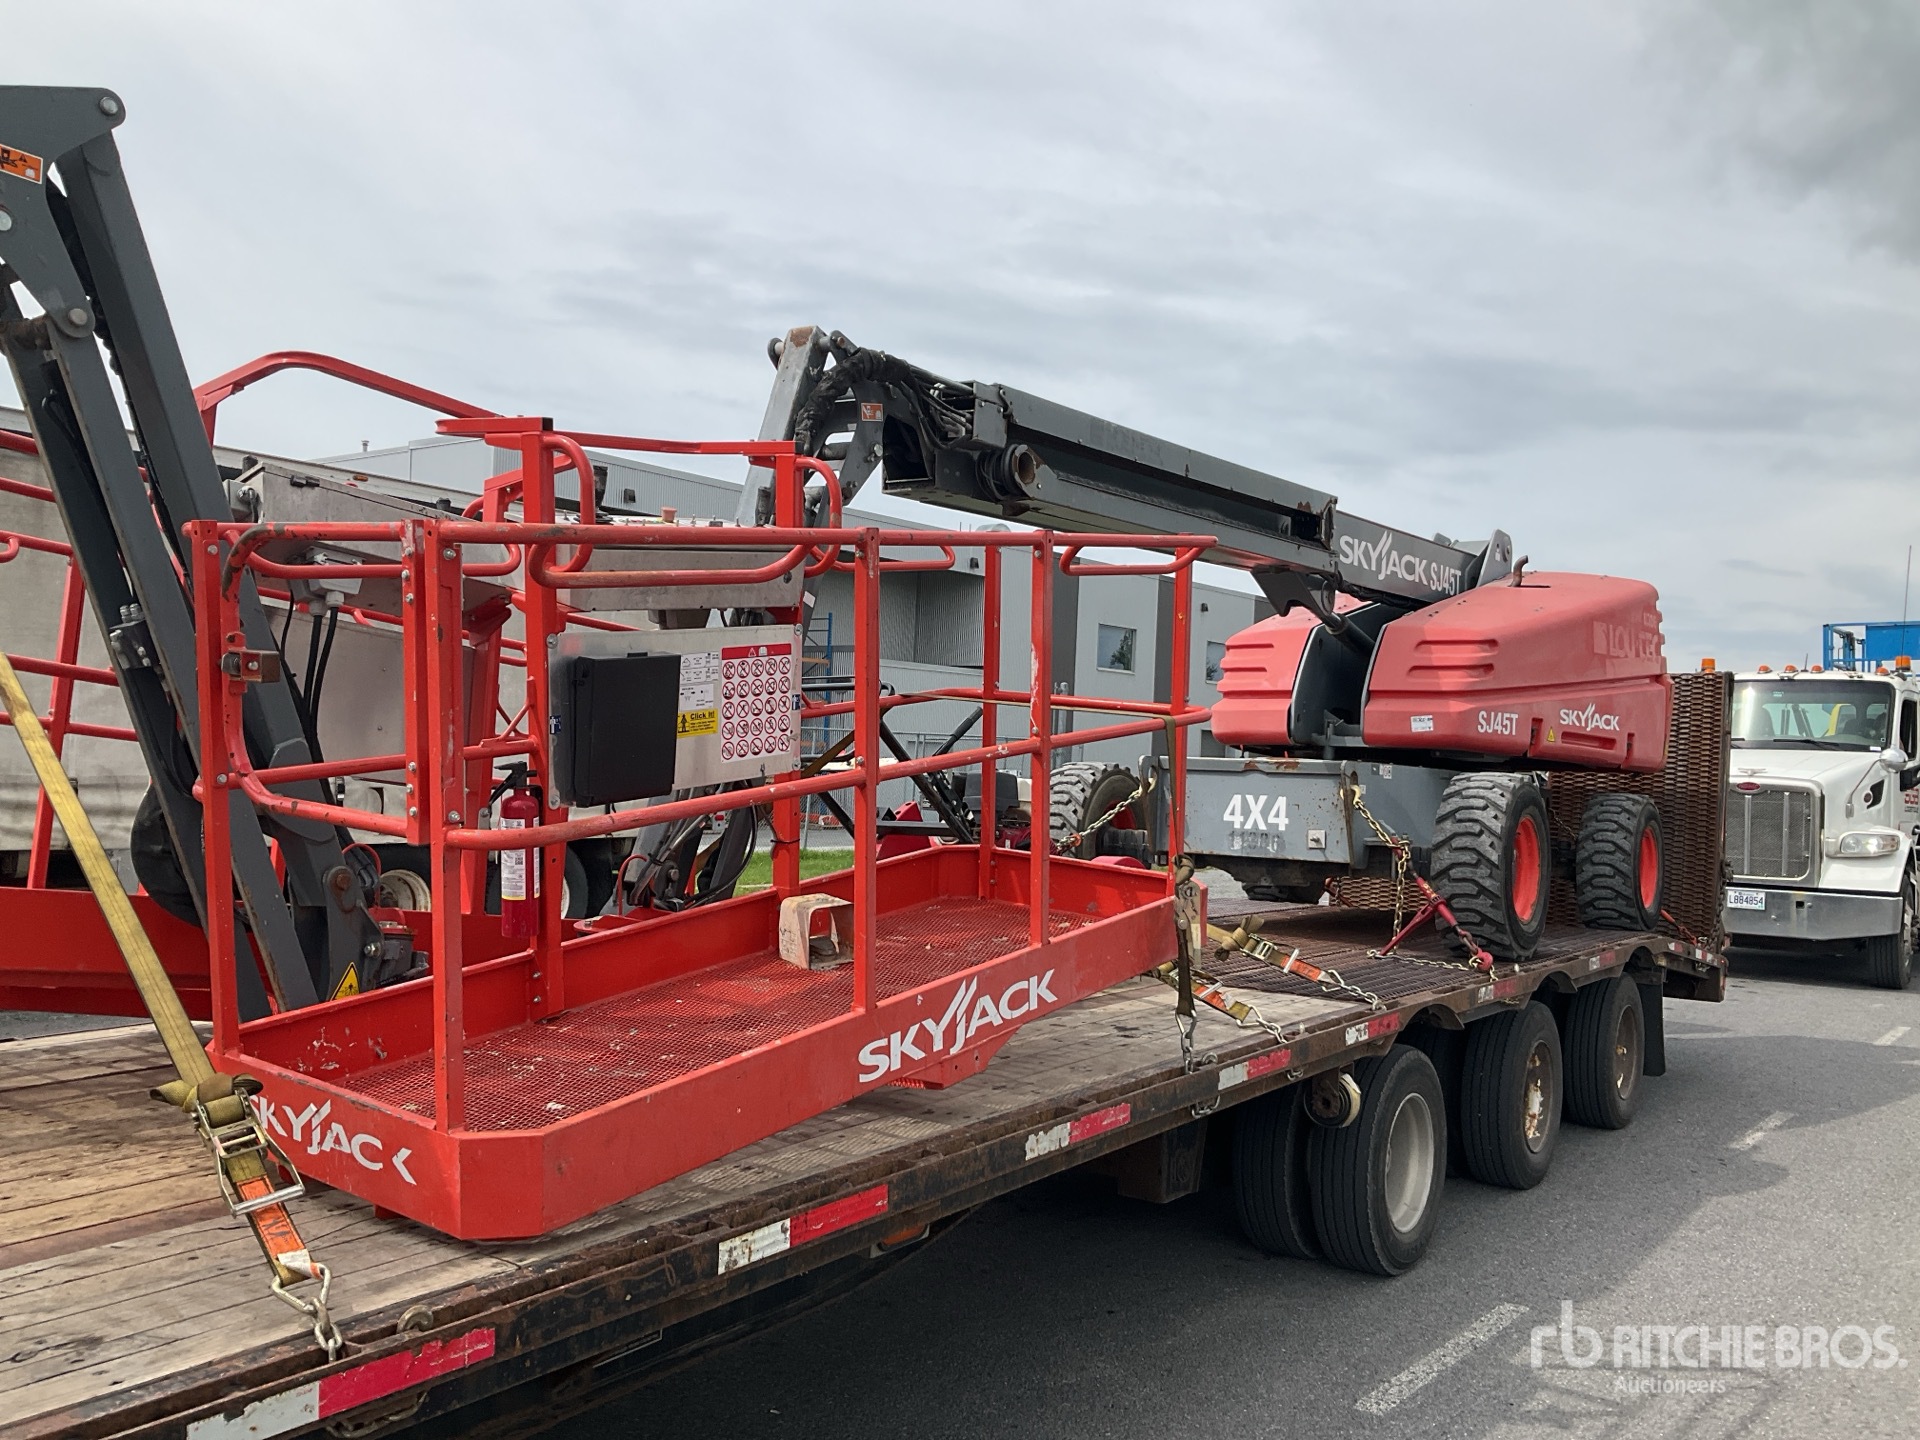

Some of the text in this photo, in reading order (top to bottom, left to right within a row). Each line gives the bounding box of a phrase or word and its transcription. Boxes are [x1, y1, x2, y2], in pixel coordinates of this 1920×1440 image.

[1340, 530, 1461, 595] SKYJACK SJ45T
[690, 712, 706, 720] Click
[1477, 710, 1519, 735] SJ45T
[1559, 703, 1619, 731] SKYJACK
[1223, 794, 1289, 831] 4X4
[858, 969, 1058, 1083] SKYJACK
